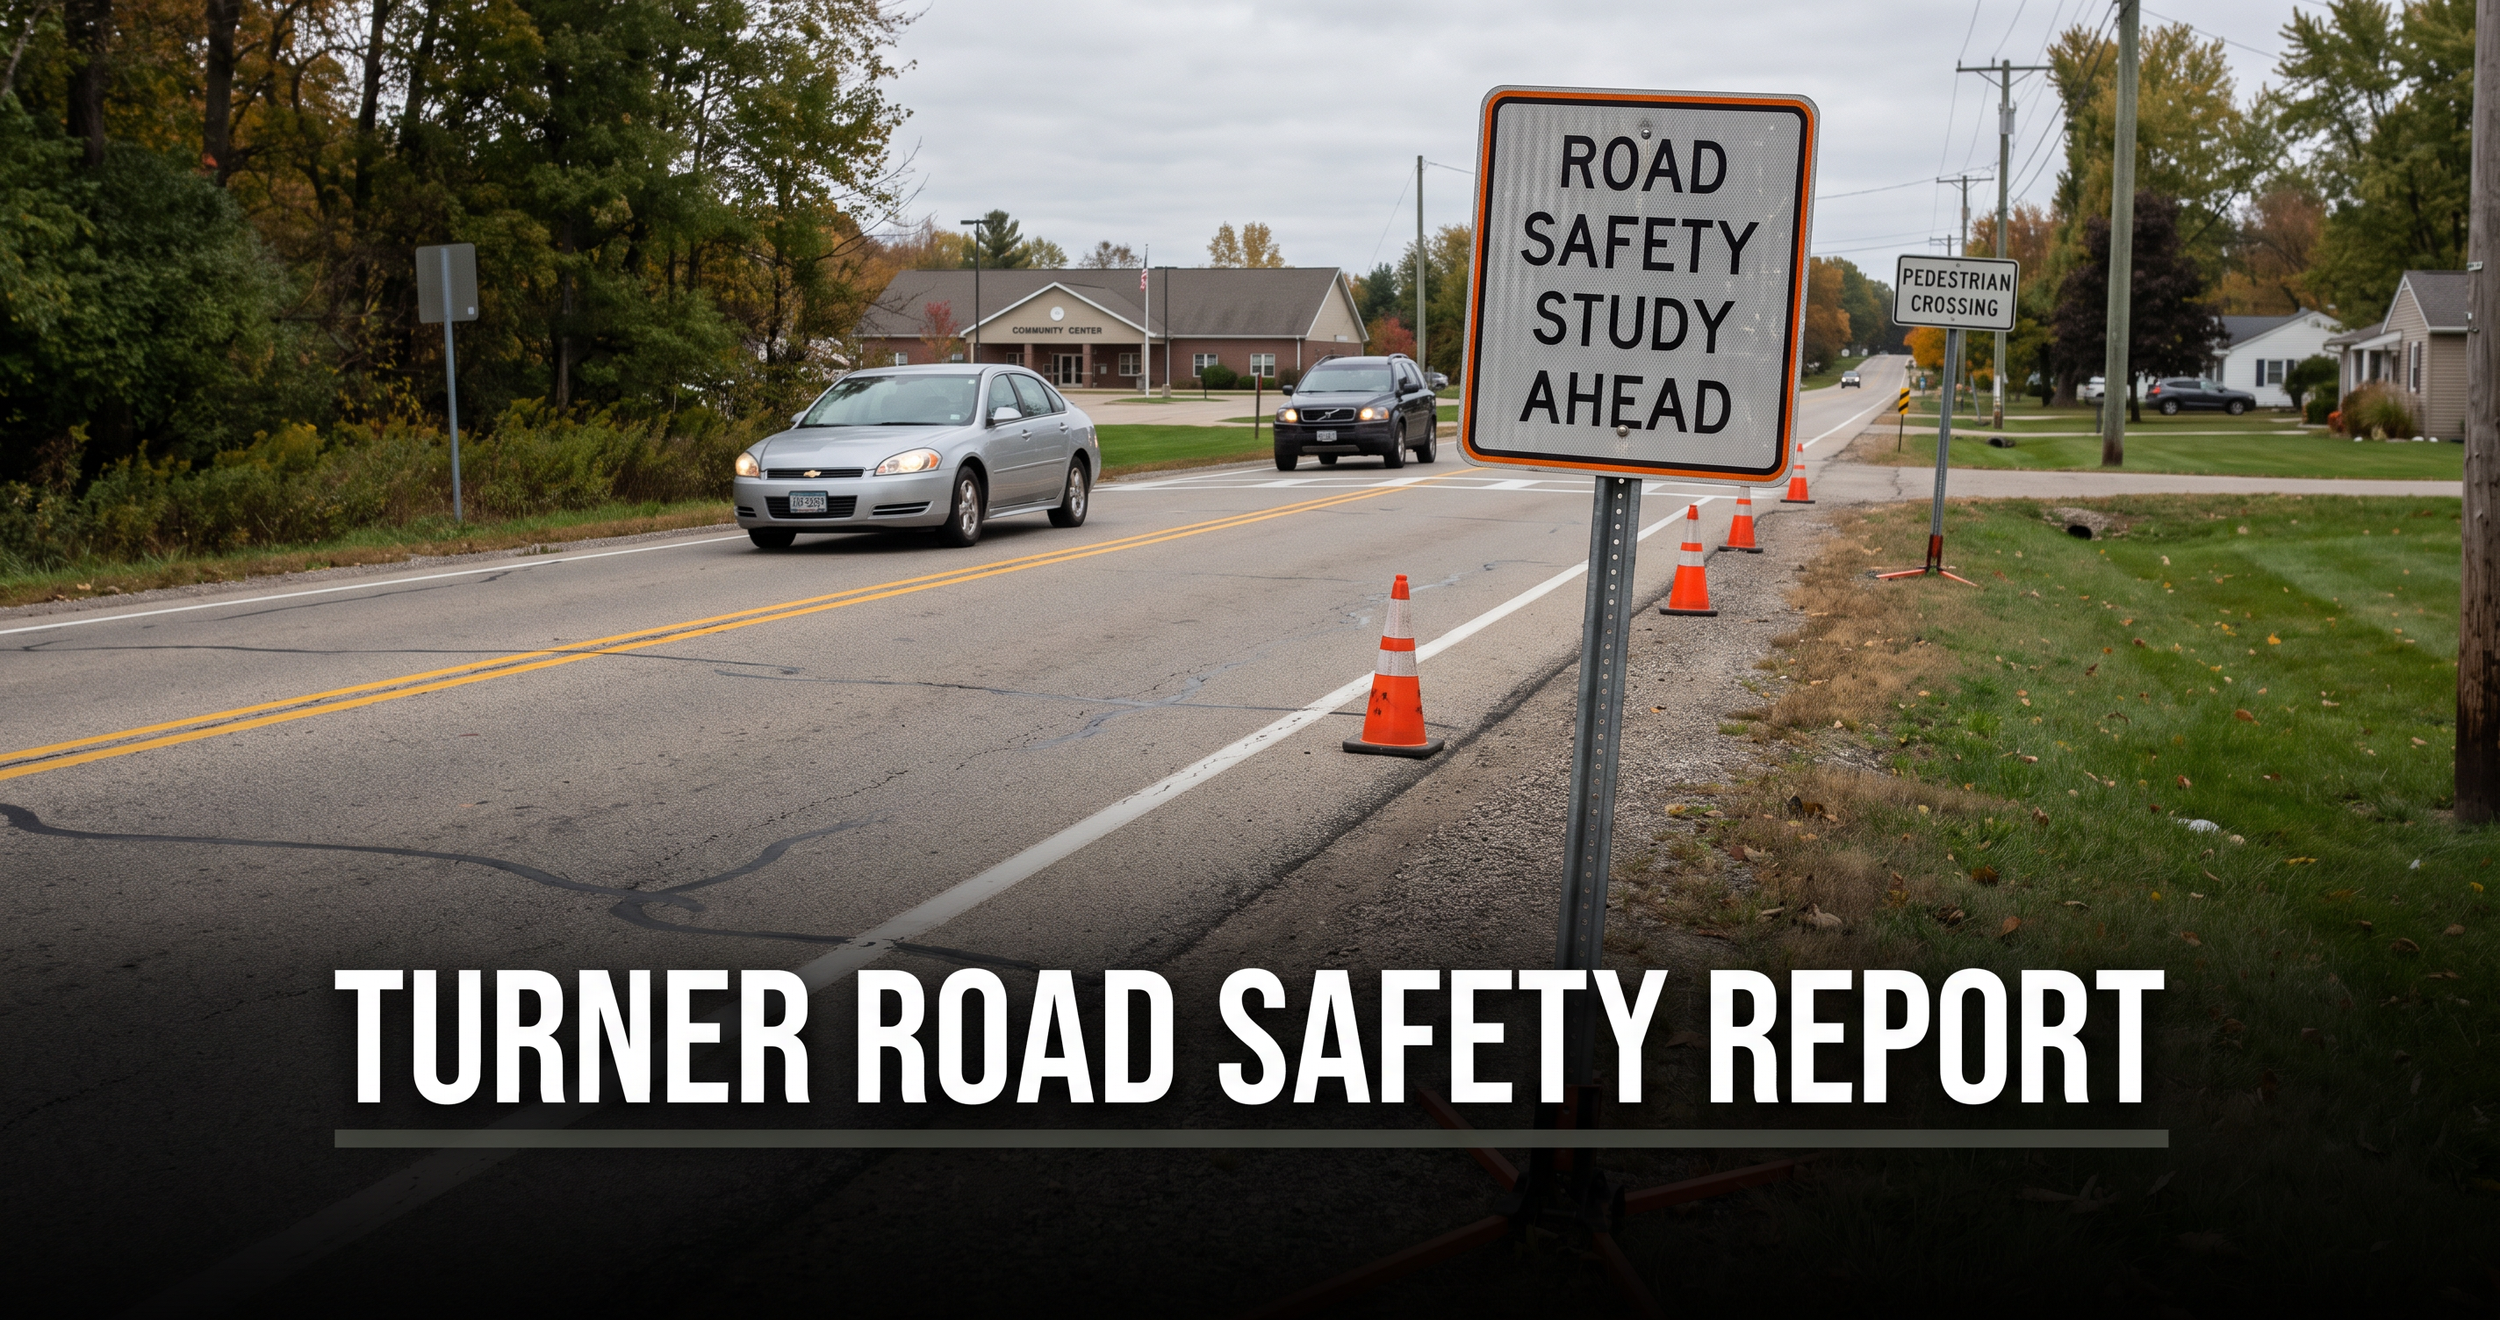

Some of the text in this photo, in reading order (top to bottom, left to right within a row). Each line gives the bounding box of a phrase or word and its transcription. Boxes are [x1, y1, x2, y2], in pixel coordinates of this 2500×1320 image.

[1560, 134, 1728, 195] ROAD
[1520, 211, 1760, 276] SAFETY
[1902, 267, 2012, 292] PEDESTRIAN
[1911, 294, 1998, 317] CROSSING
[1012, 326, 1102, 335] COMMUNITY CENTER
[1532, 290, 1736, 354] STUDY
[1518, 369, 1732, 435] AHEAD
